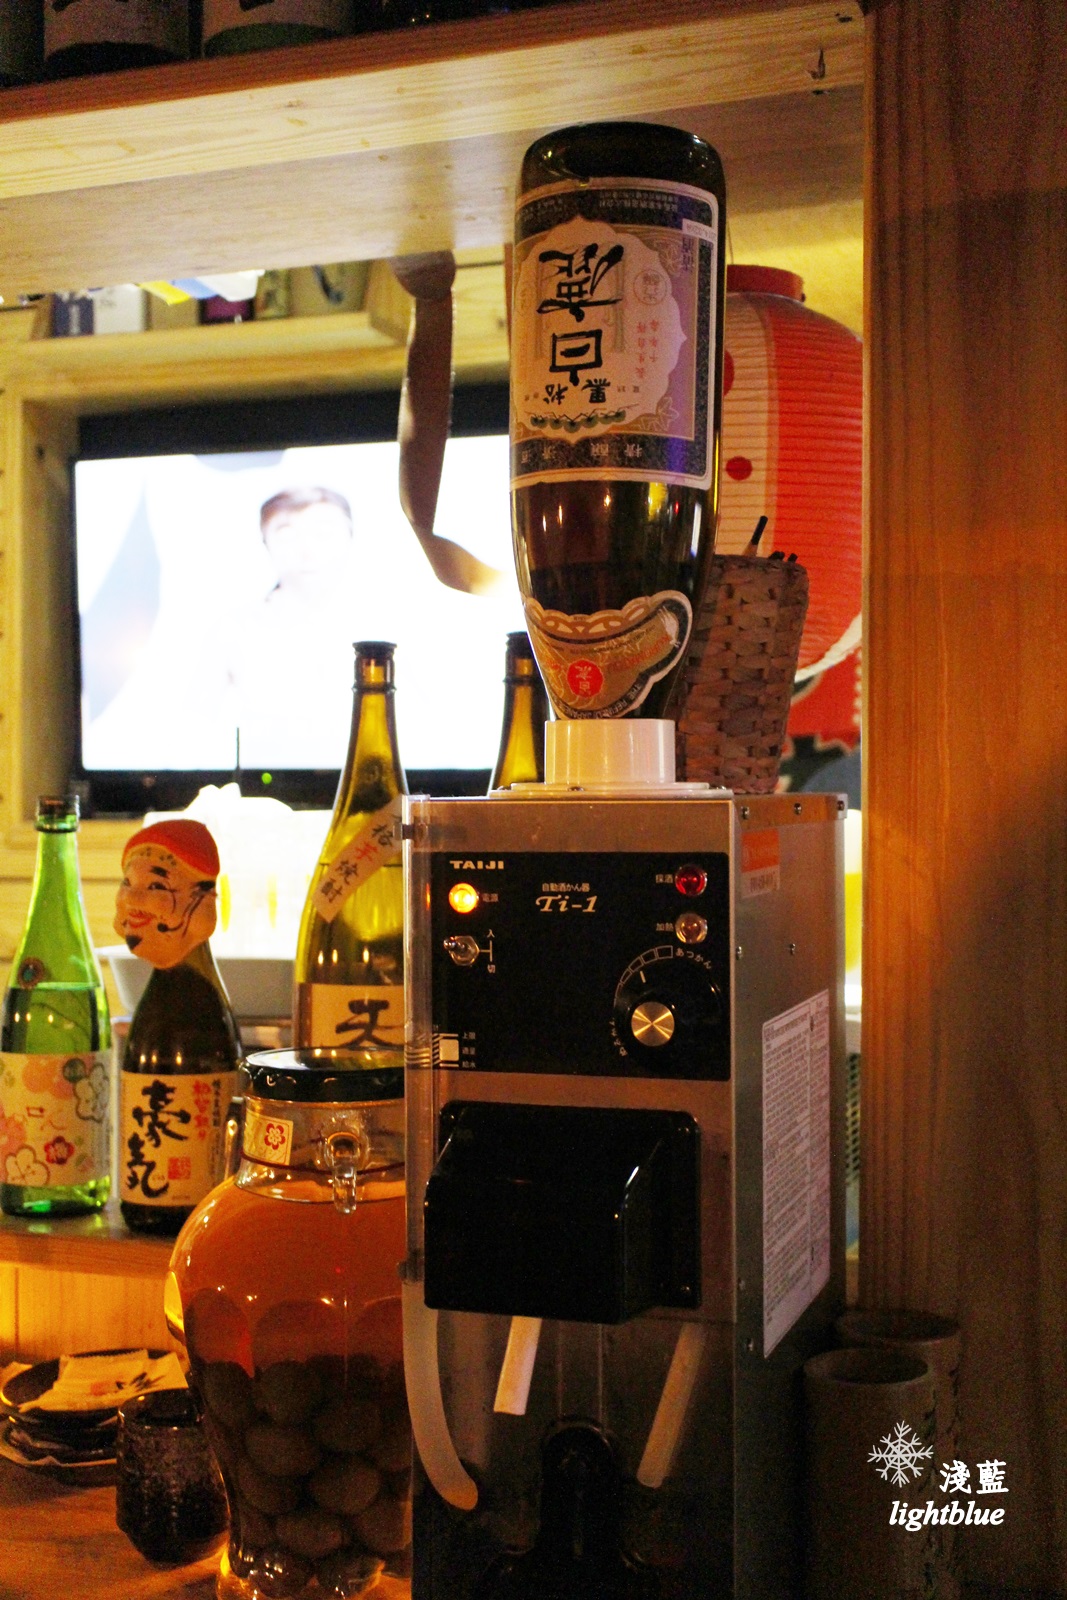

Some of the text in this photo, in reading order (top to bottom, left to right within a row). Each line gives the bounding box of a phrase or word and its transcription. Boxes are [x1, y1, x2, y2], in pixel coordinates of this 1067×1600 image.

[537, 242, 625, 387] 白鹿
[320, 815, 402, 904] 格芋焼酎
[449, 860, 505, 870] TAIJI
[535, 894, 598, 913] Ti-1
[486, 928, 496, 938] 入
[675, 947, 712, 970] あつかん
